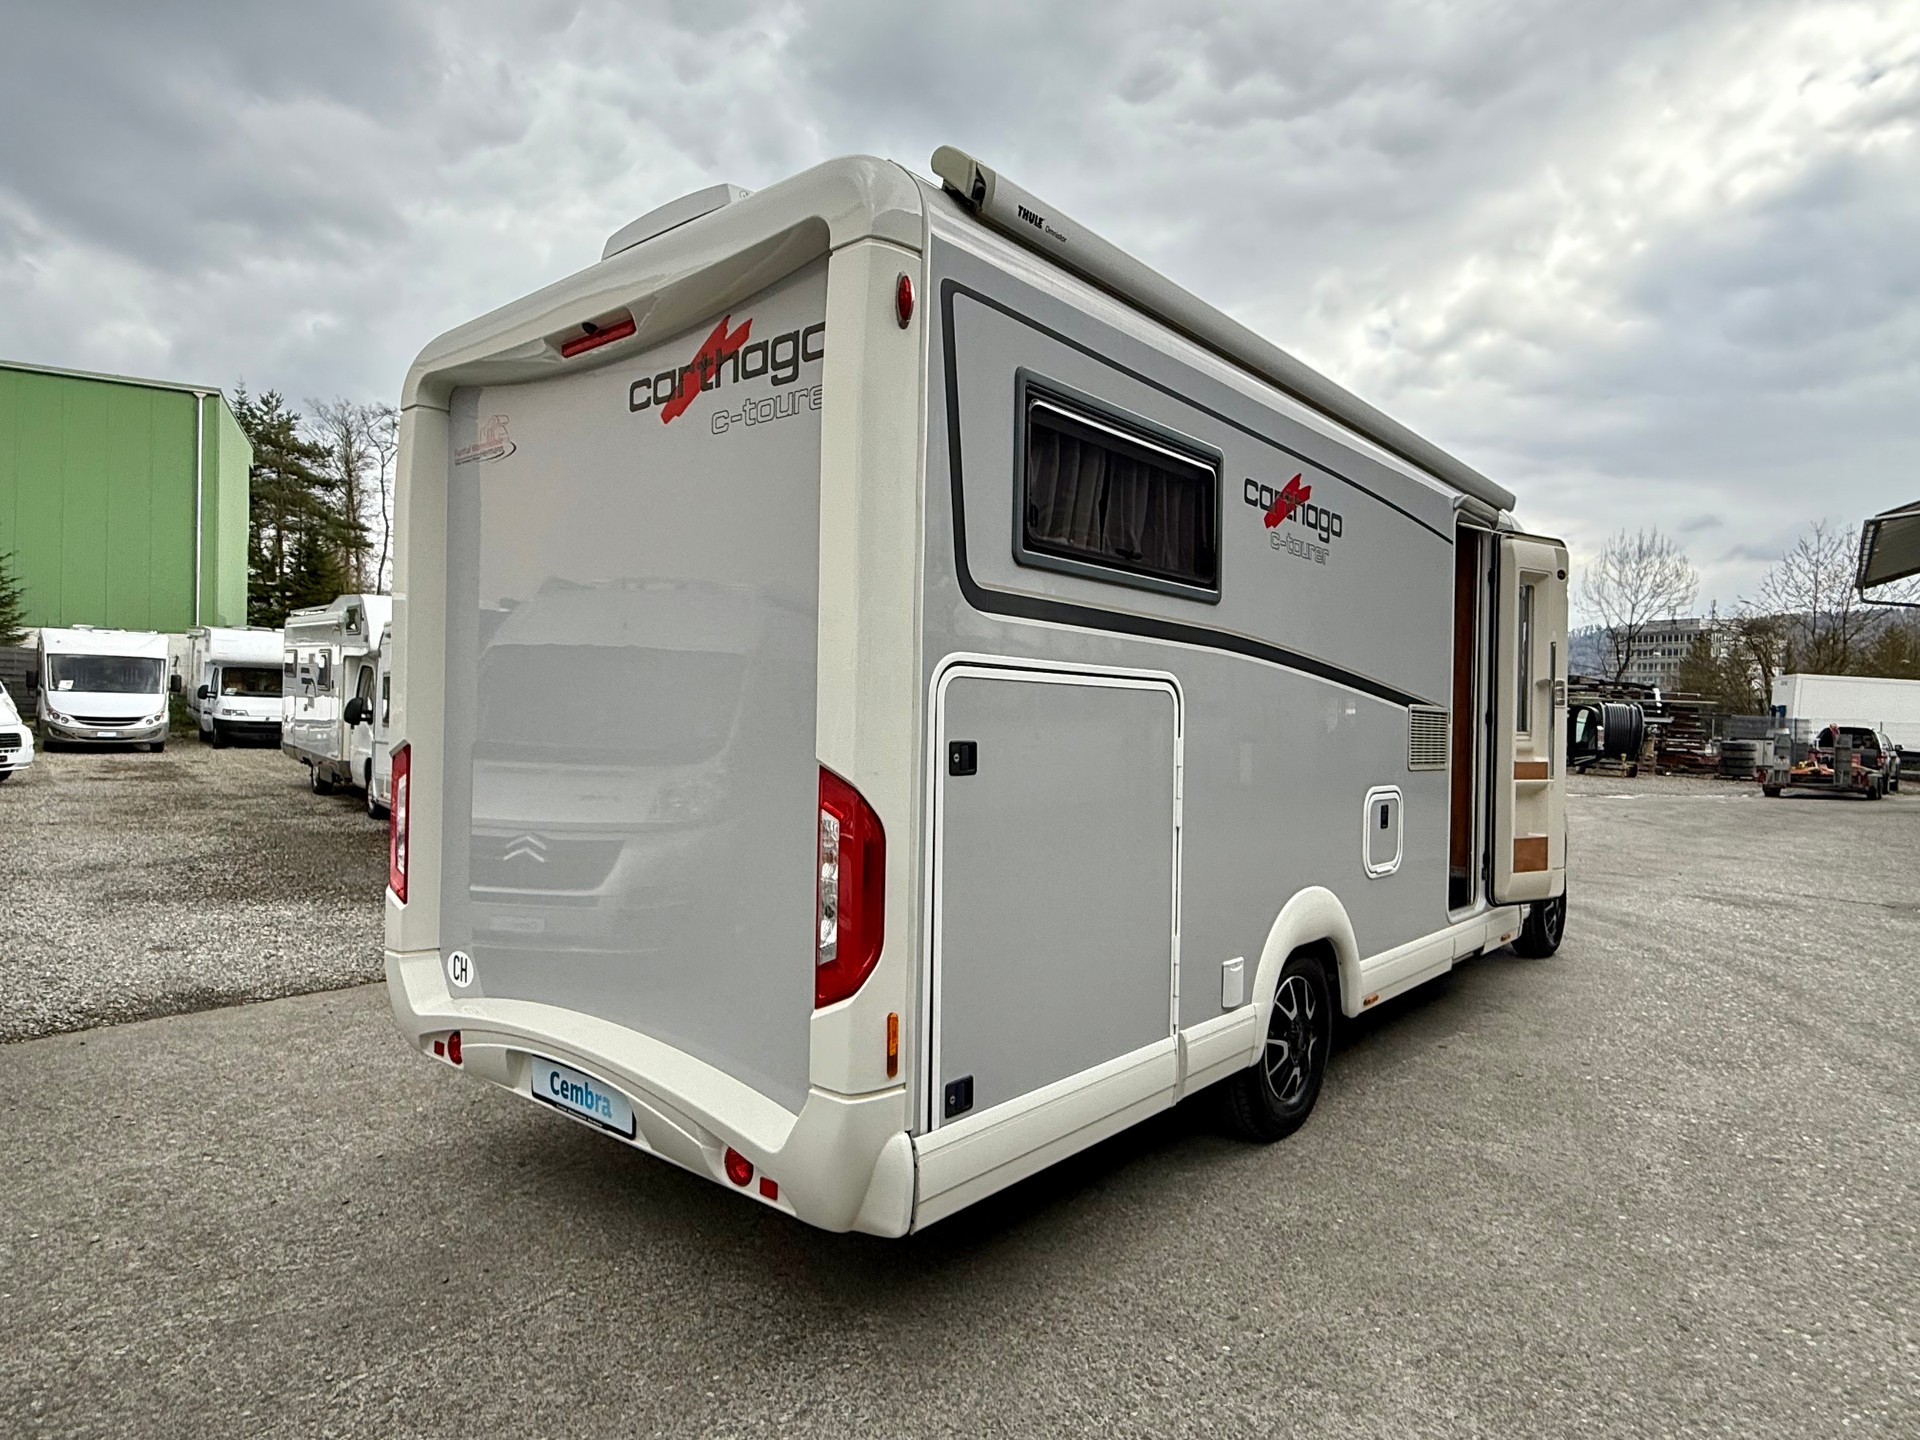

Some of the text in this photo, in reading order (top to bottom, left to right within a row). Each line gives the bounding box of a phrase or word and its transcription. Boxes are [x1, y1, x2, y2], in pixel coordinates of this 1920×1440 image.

[1018, 204, 1043, 230] THULE
[629, 321, 826, 412] carthago
[711, 384, 823, 435] c-toure
[1243, 478, 1343, 543] carthago
[1270, 531, 1330, 565] c-tourer
[453, 954, 468, 984] CH
[550, 1070, 613, 1119] Cembra
